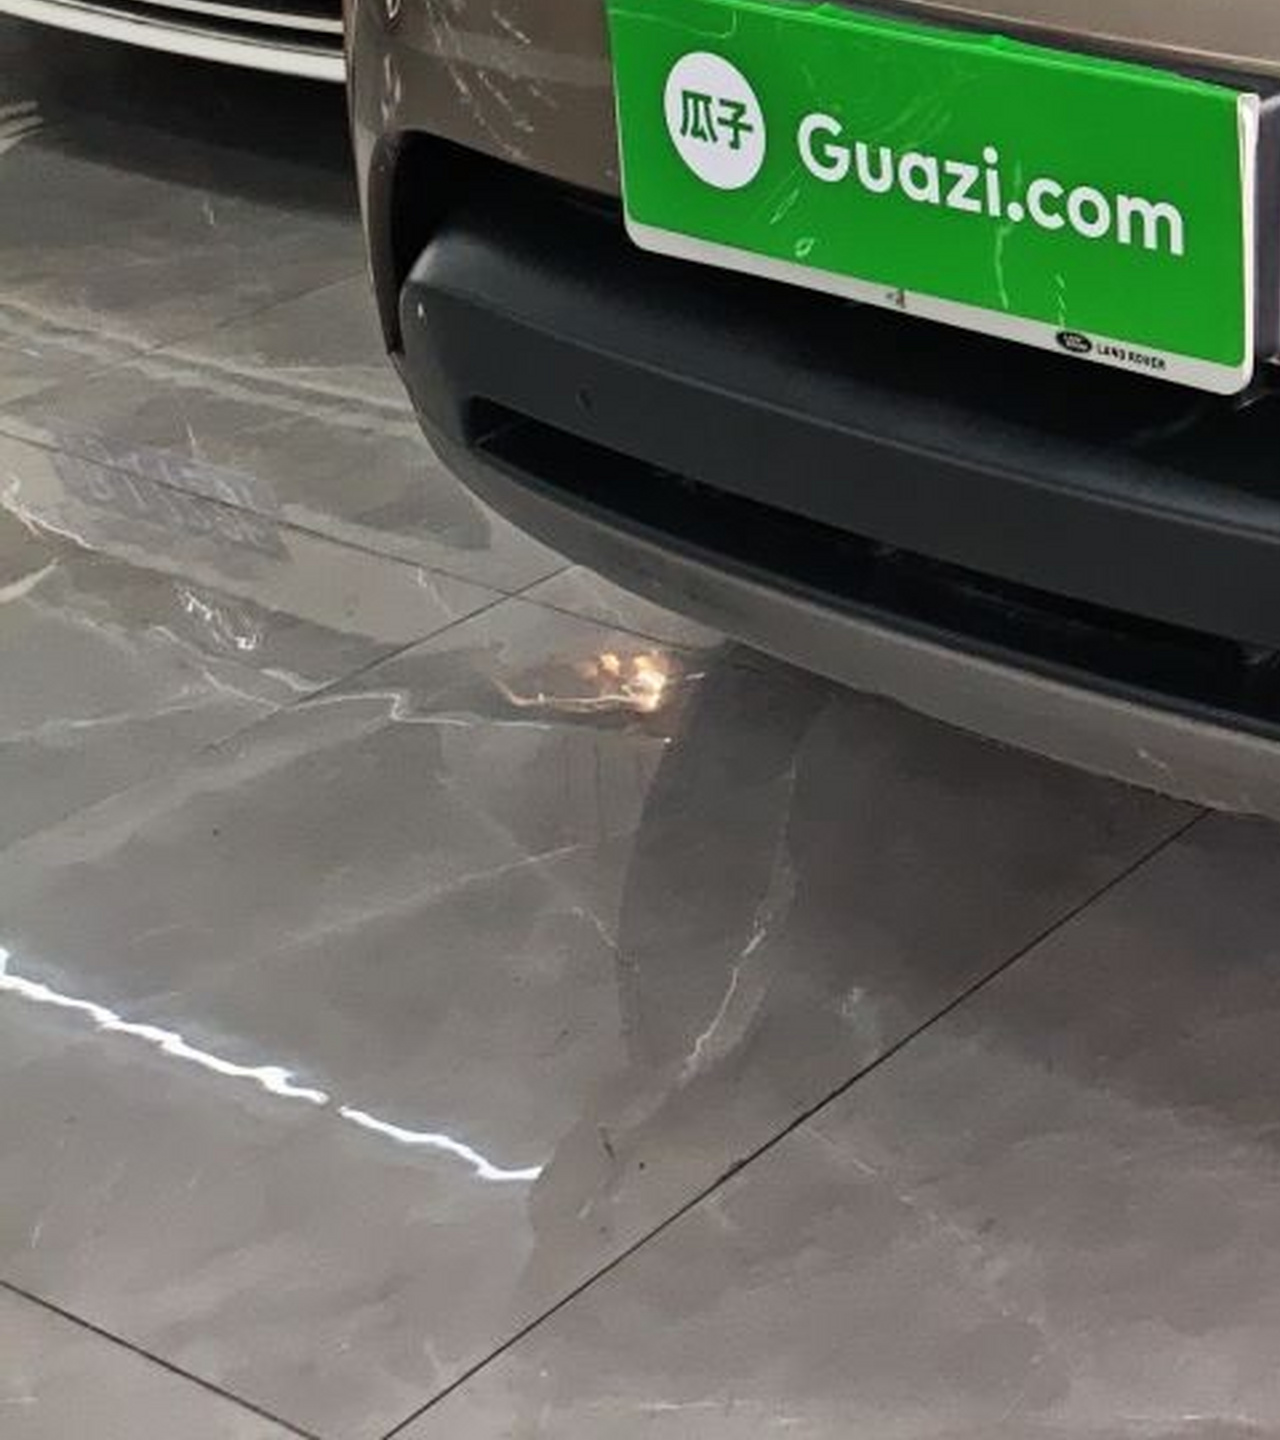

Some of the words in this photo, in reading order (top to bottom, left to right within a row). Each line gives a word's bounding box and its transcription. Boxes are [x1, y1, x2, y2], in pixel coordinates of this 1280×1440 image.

[679, 89, 754, 150] 瓜子
[796, 112, 1185, 256] Guazi.com
[1096, 343, 1126, 361] LAND
[1128, 351, 1166, 371] ROVER
